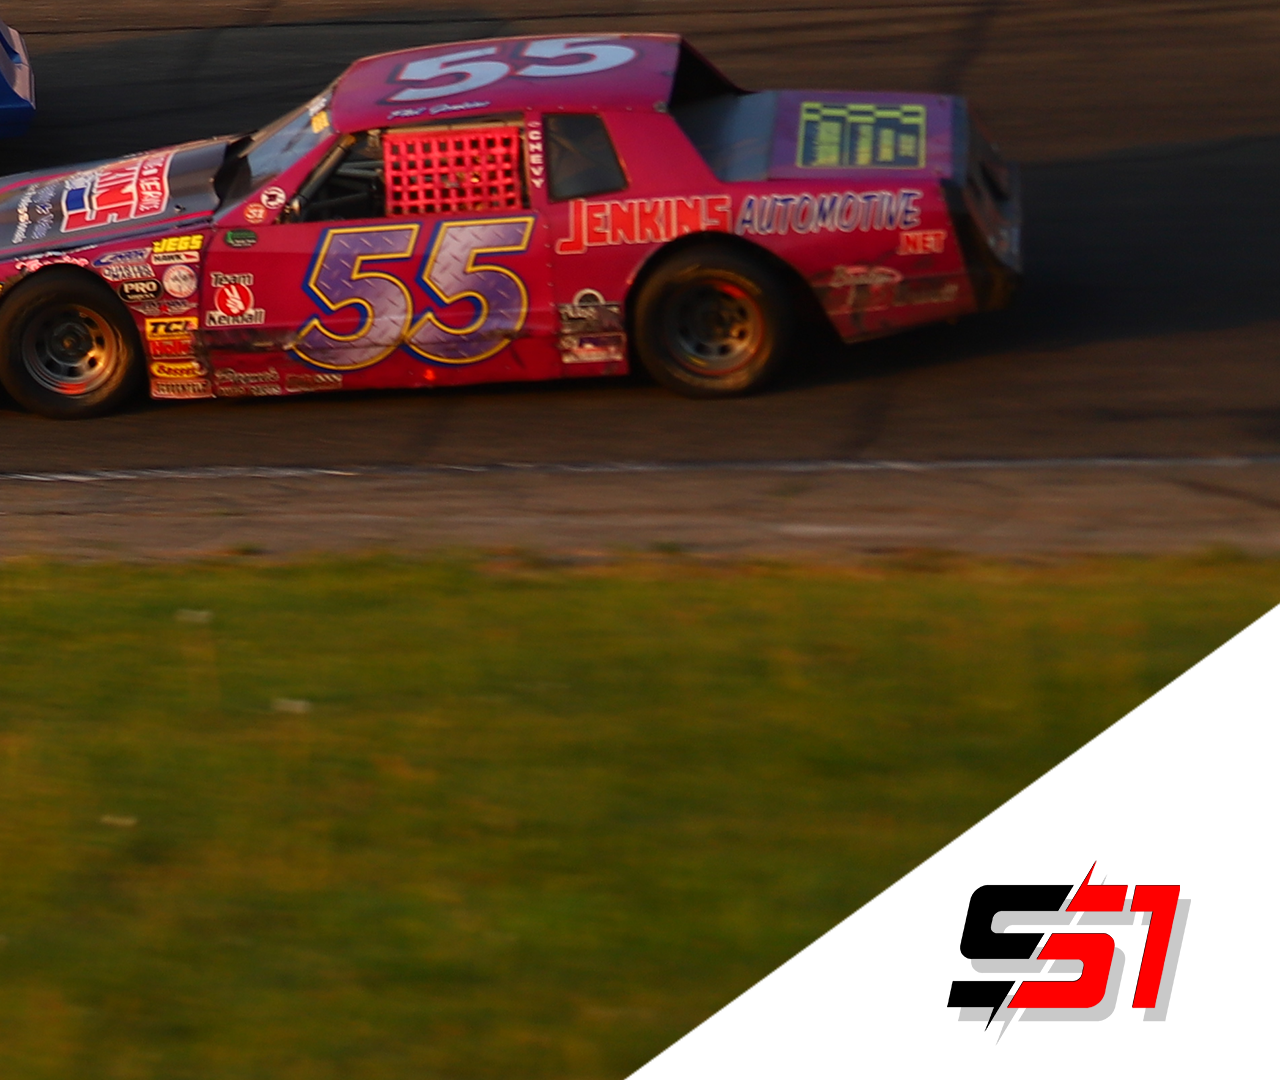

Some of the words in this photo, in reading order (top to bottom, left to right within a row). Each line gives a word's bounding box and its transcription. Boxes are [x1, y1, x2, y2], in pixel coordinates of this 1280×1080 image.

[385, 37, 636, 103] 55
[555, 196, 732, 254] JENKINS
[735, 189, 923, 235] AUTOMOTIVE
[153, 234, 203, 253] JEGS
[123, 281, 159, 294] PRO
[210, 272, 253, 286] Team
[287, 216, 537, 371] 55
